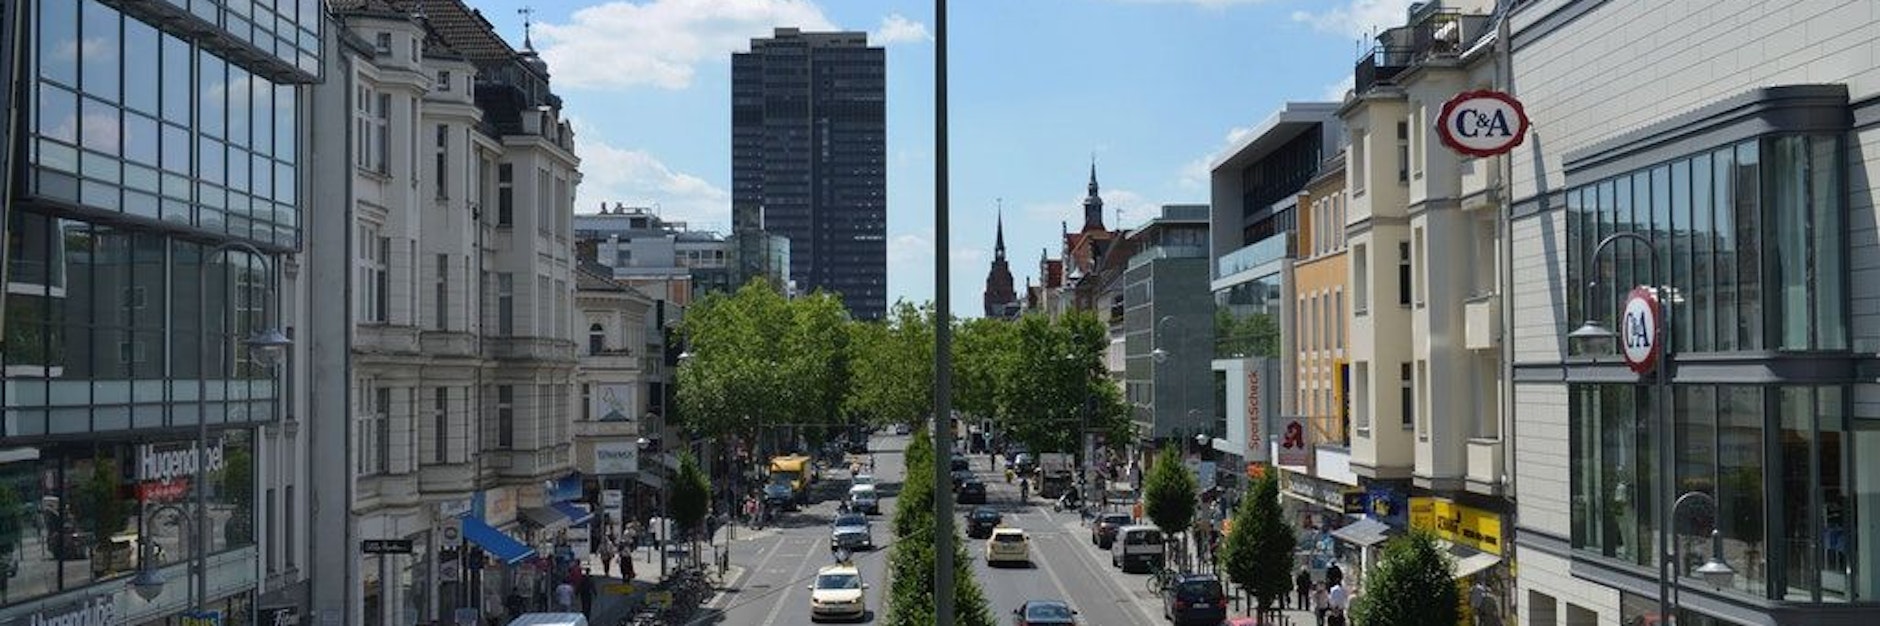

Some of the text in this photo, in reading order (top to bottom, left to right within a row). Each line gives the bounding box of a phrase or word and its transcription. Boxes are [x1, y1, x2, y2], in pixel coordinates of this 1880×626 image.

[1456, 108, 1512, 138] C&A
[1626, 311, 1650, 348] C&A
[1248, 369, 1260, 451] SportScheck
